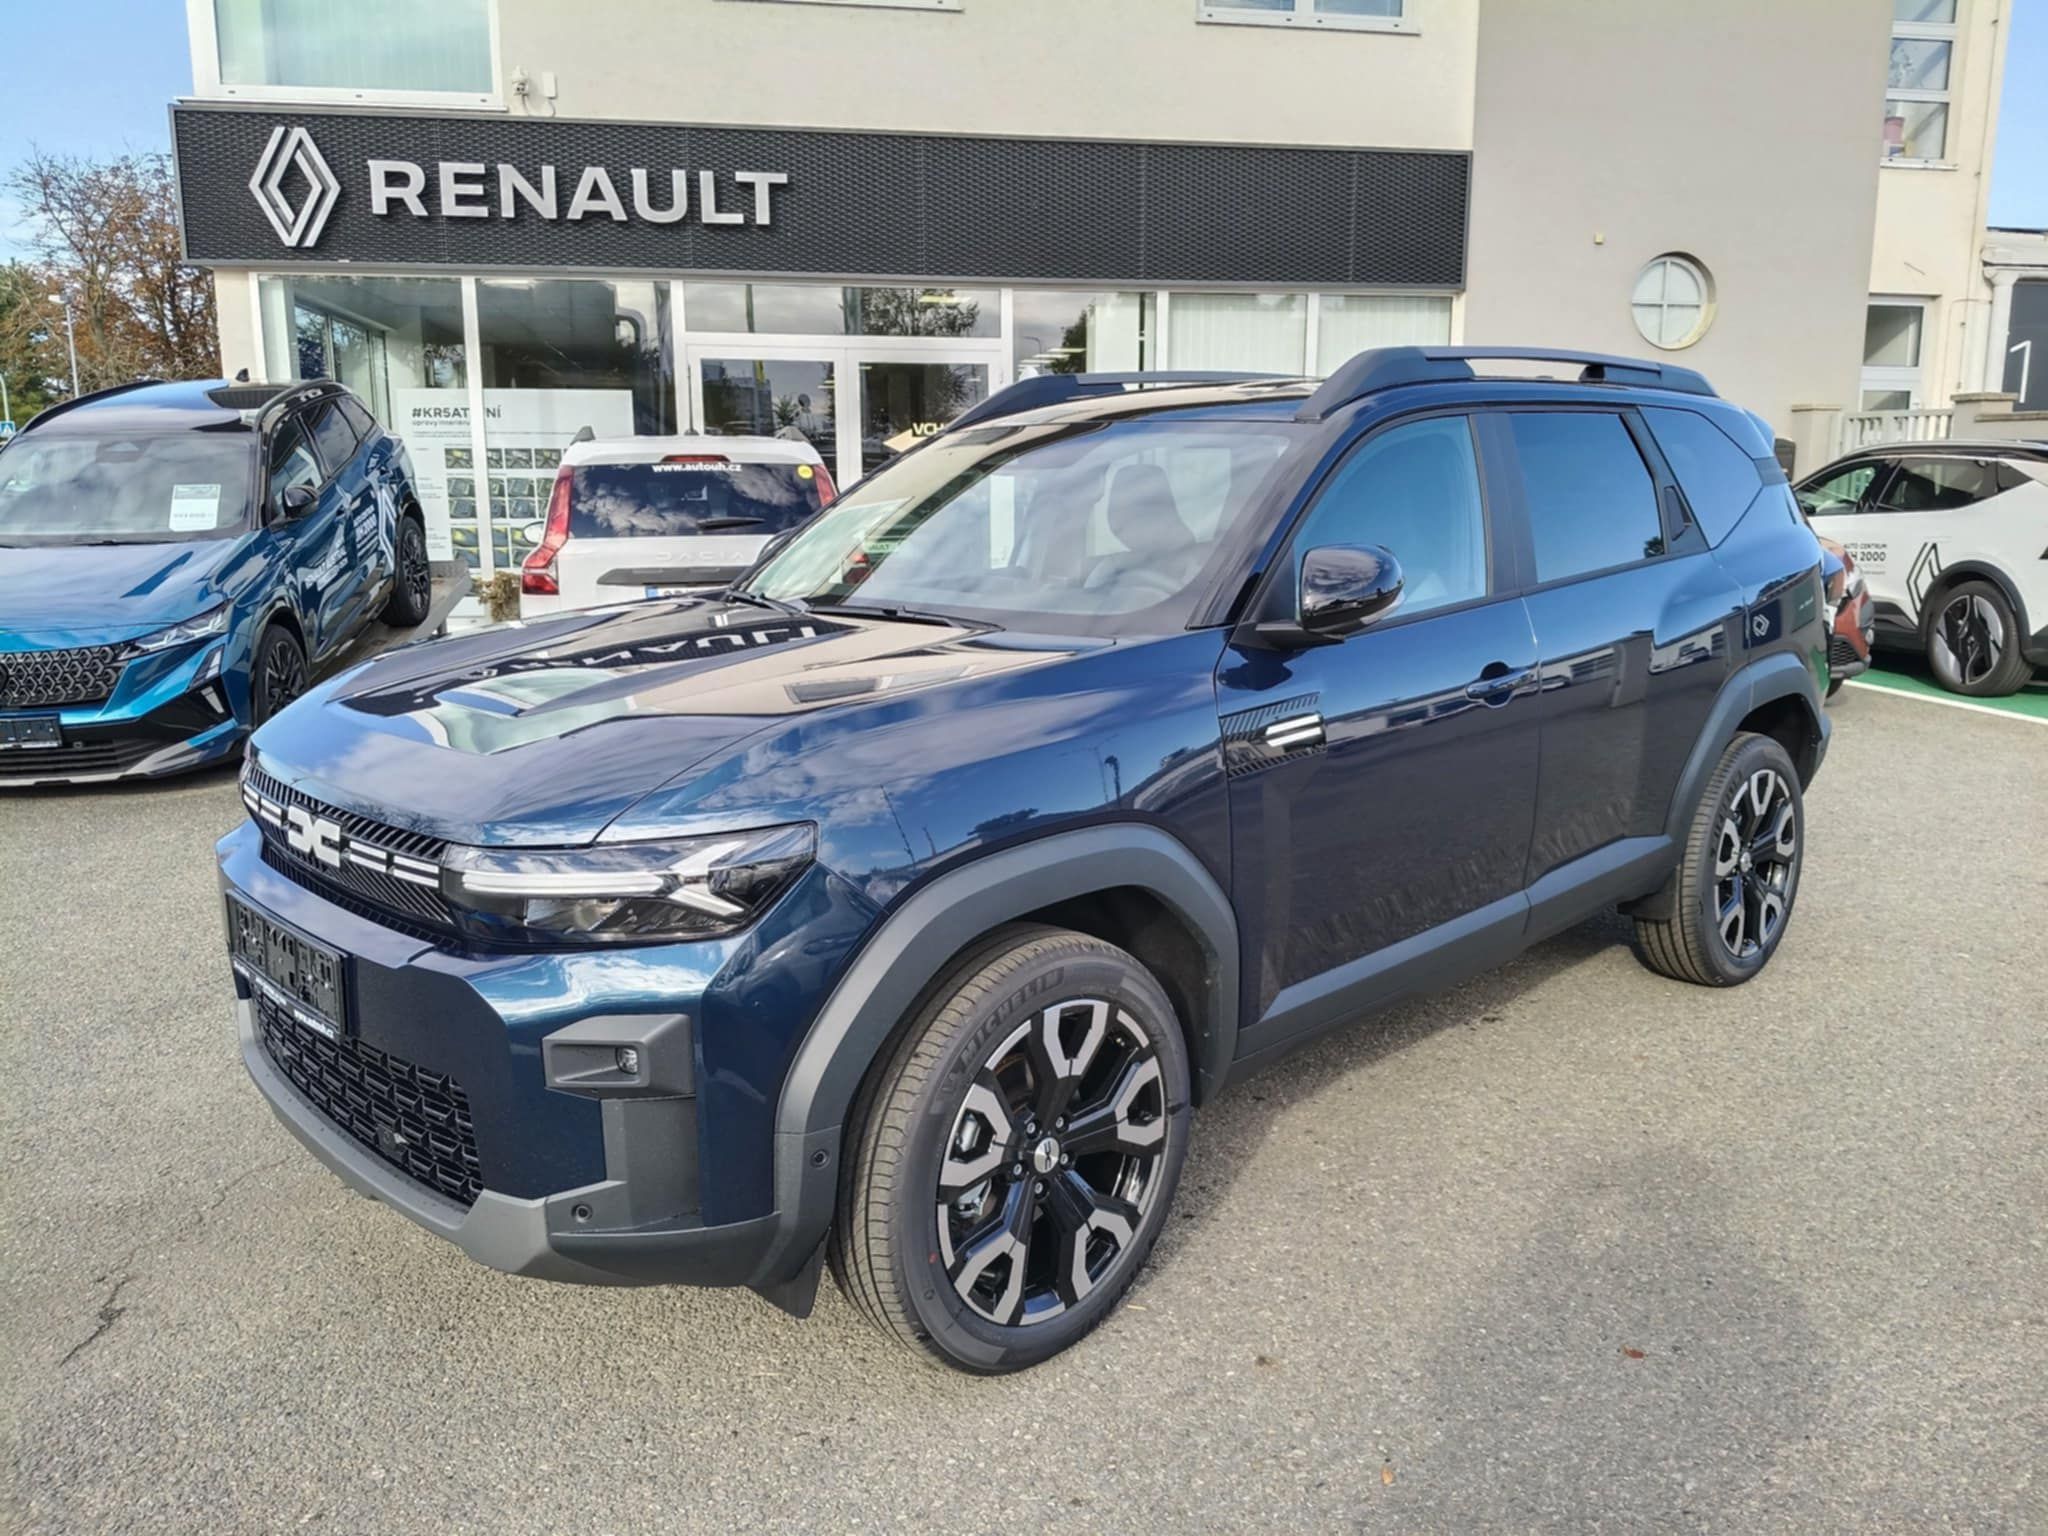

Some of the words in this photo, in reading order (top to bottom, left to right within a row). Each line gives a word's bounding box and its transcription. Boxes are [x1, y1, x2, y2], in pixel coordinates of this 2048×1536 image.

[367, 159, 788, 225] RENAULT
[2009, 340, 2031, 403] 1
[652, 462, 742, 472] www.autouh.cz
[1860, 551, 1886, 561] 2000
